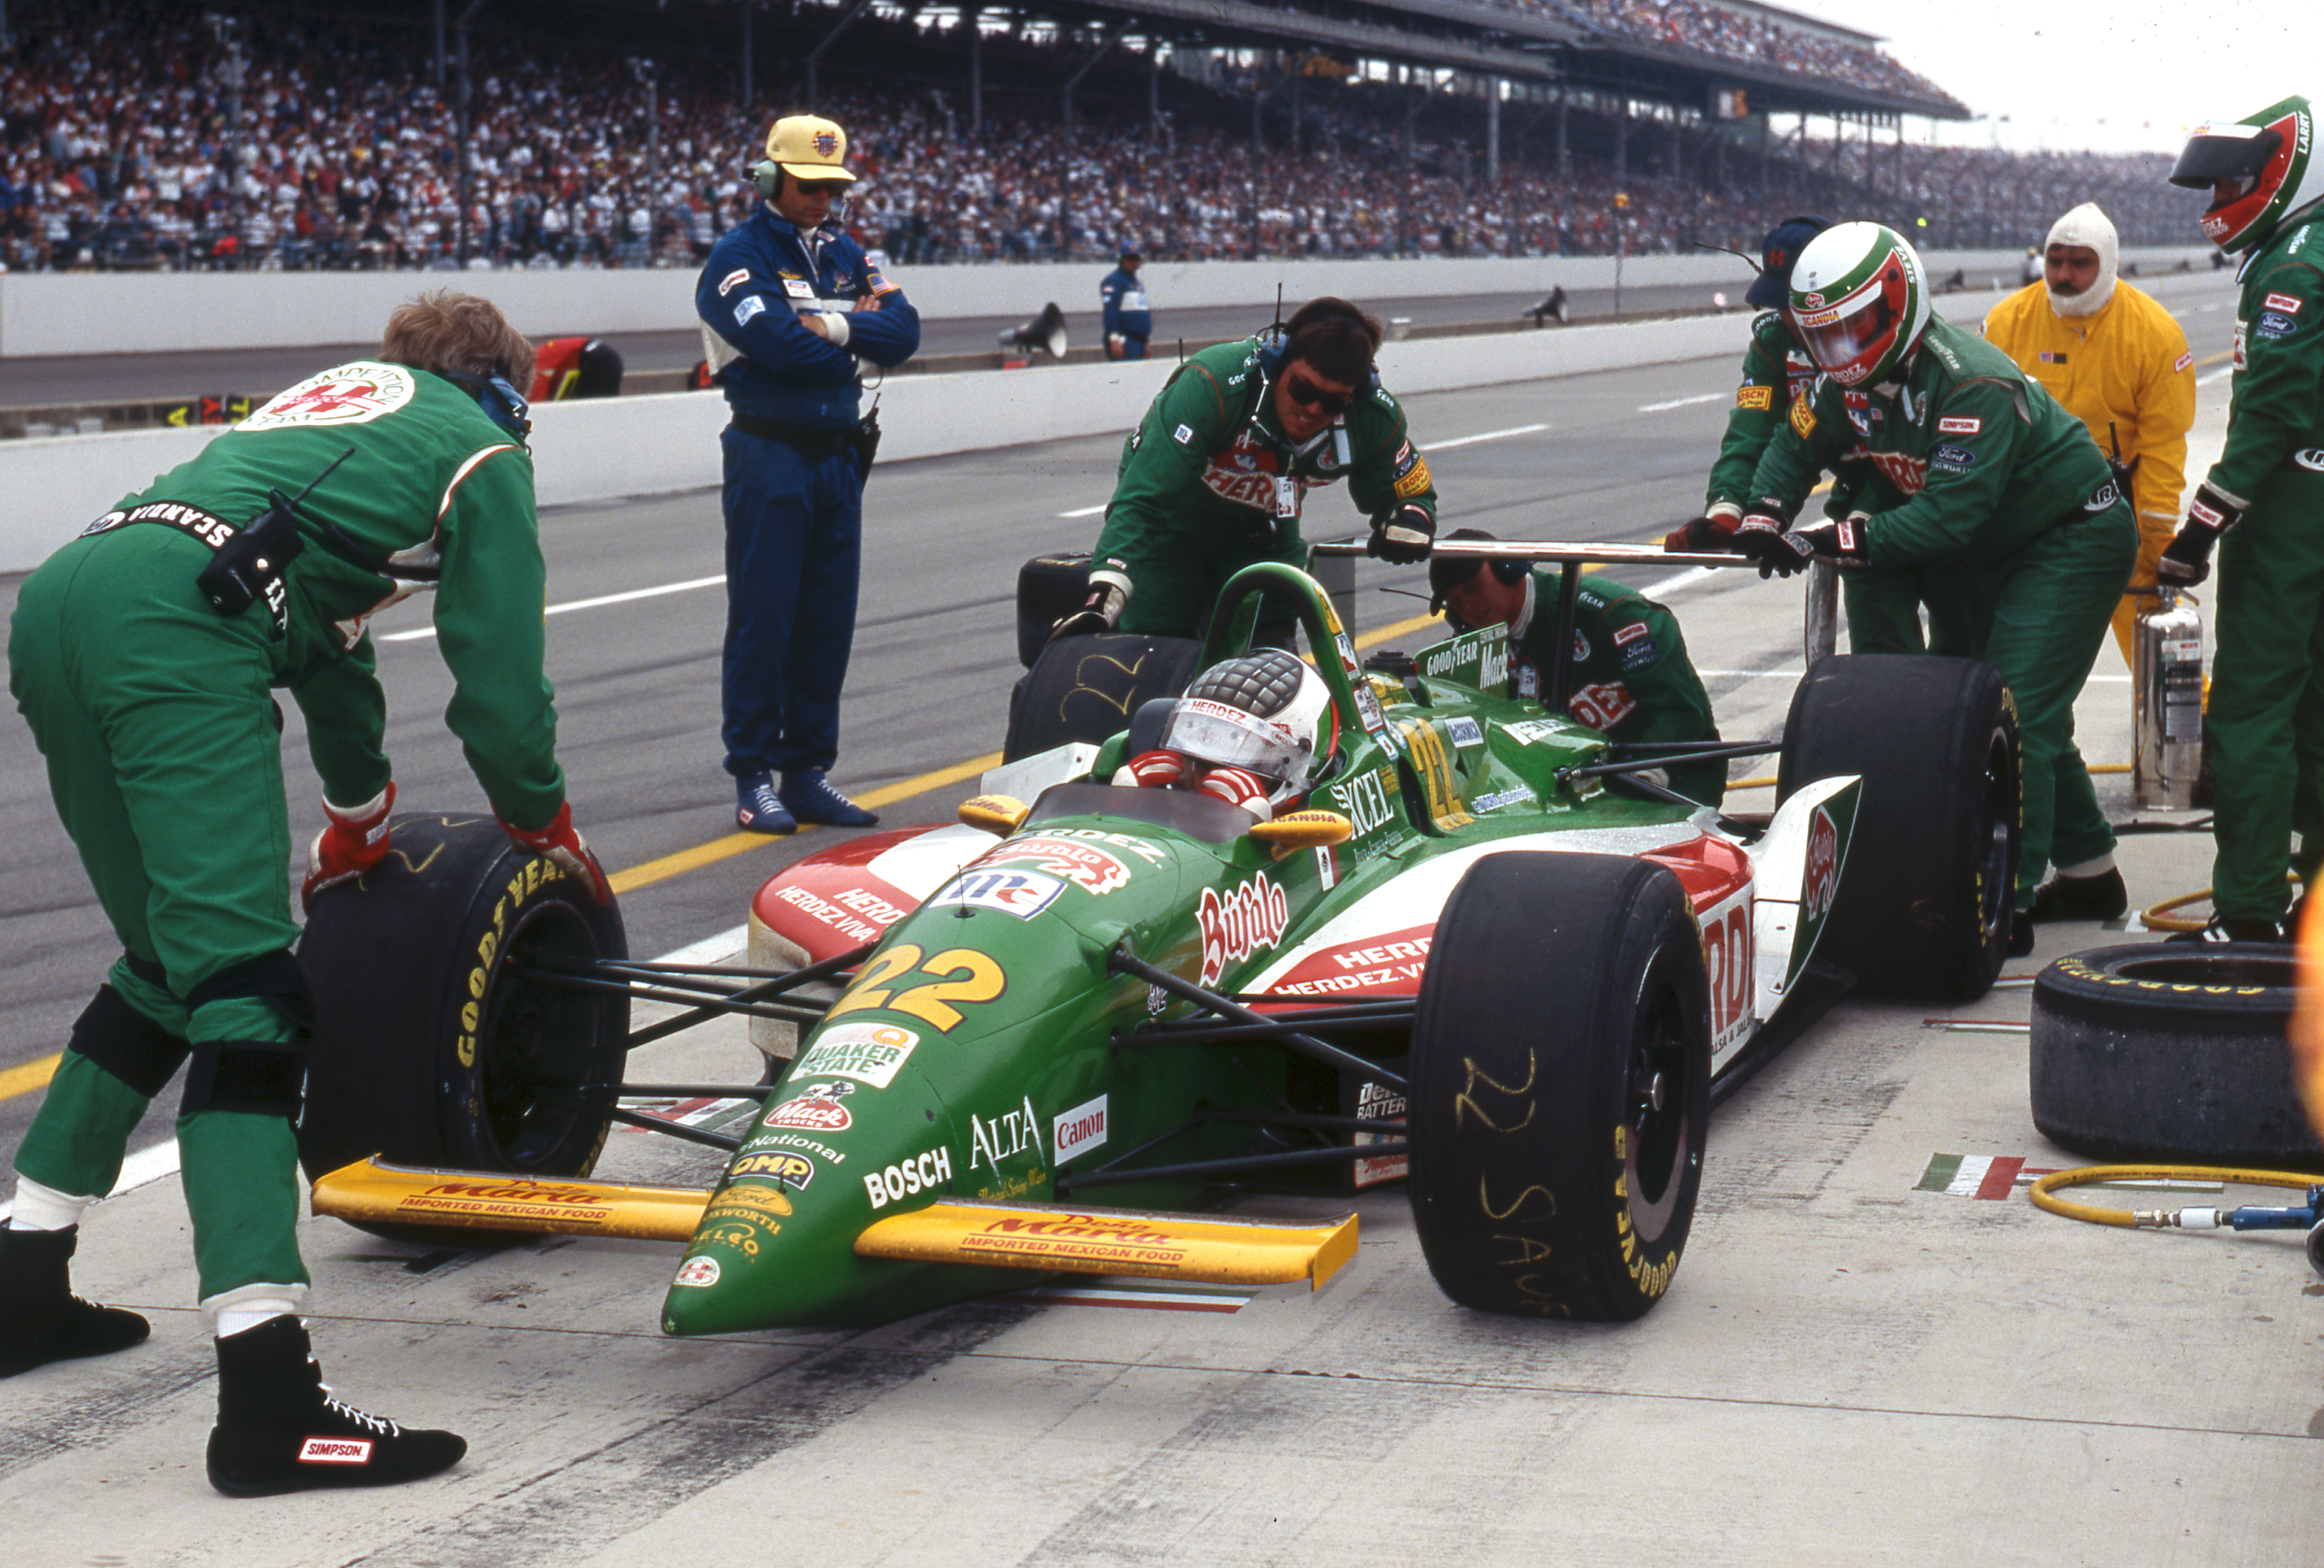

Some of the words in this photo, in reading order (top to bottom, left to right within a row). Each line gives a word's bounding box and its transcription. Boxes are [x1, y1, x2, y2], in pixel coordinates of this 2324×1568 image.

[2297, 110, 2310, 155] LARRY
[1802, 310, 1840, 326] SCANDIA
[1942, 420, 1975, 429] SIMPSON
[1938, 447, 1966, 462] Ford
[127, 503, 234, 548] SCANDIA
[1627, 642, 1652, 658] Ford
[822, 943, 1006, 1037] 22
[803, 1040, 901, 1065] QUAKER
[801, 1055, 873, 1077] STATE
[773, 1103, 845, 1126] Mack
[1057, 1110, 1104, 1150] Canon
[748, 1134, 846, 1164] National
[969, 1094, 1045, 1190] ALTA
[730, 1155, 809, 1176] OMP
[863, 1145, 952, 1209] BOSCH
[401, 1198, 480, 1210] IMPORTED
[485, 1203, 557, 1216] MEXICAN
[562, 1209, 607, 1219] FOOD
[720, 1188, 776, 1207] Ford
[961, 1236, 1050, 1251] IMPORTED
[1053, 1244, 1131, 1258] MEXICAN
[1135, 1251, 1184, 1261] FOOD
[307, 1443, 363, 1457] SIMPSON
